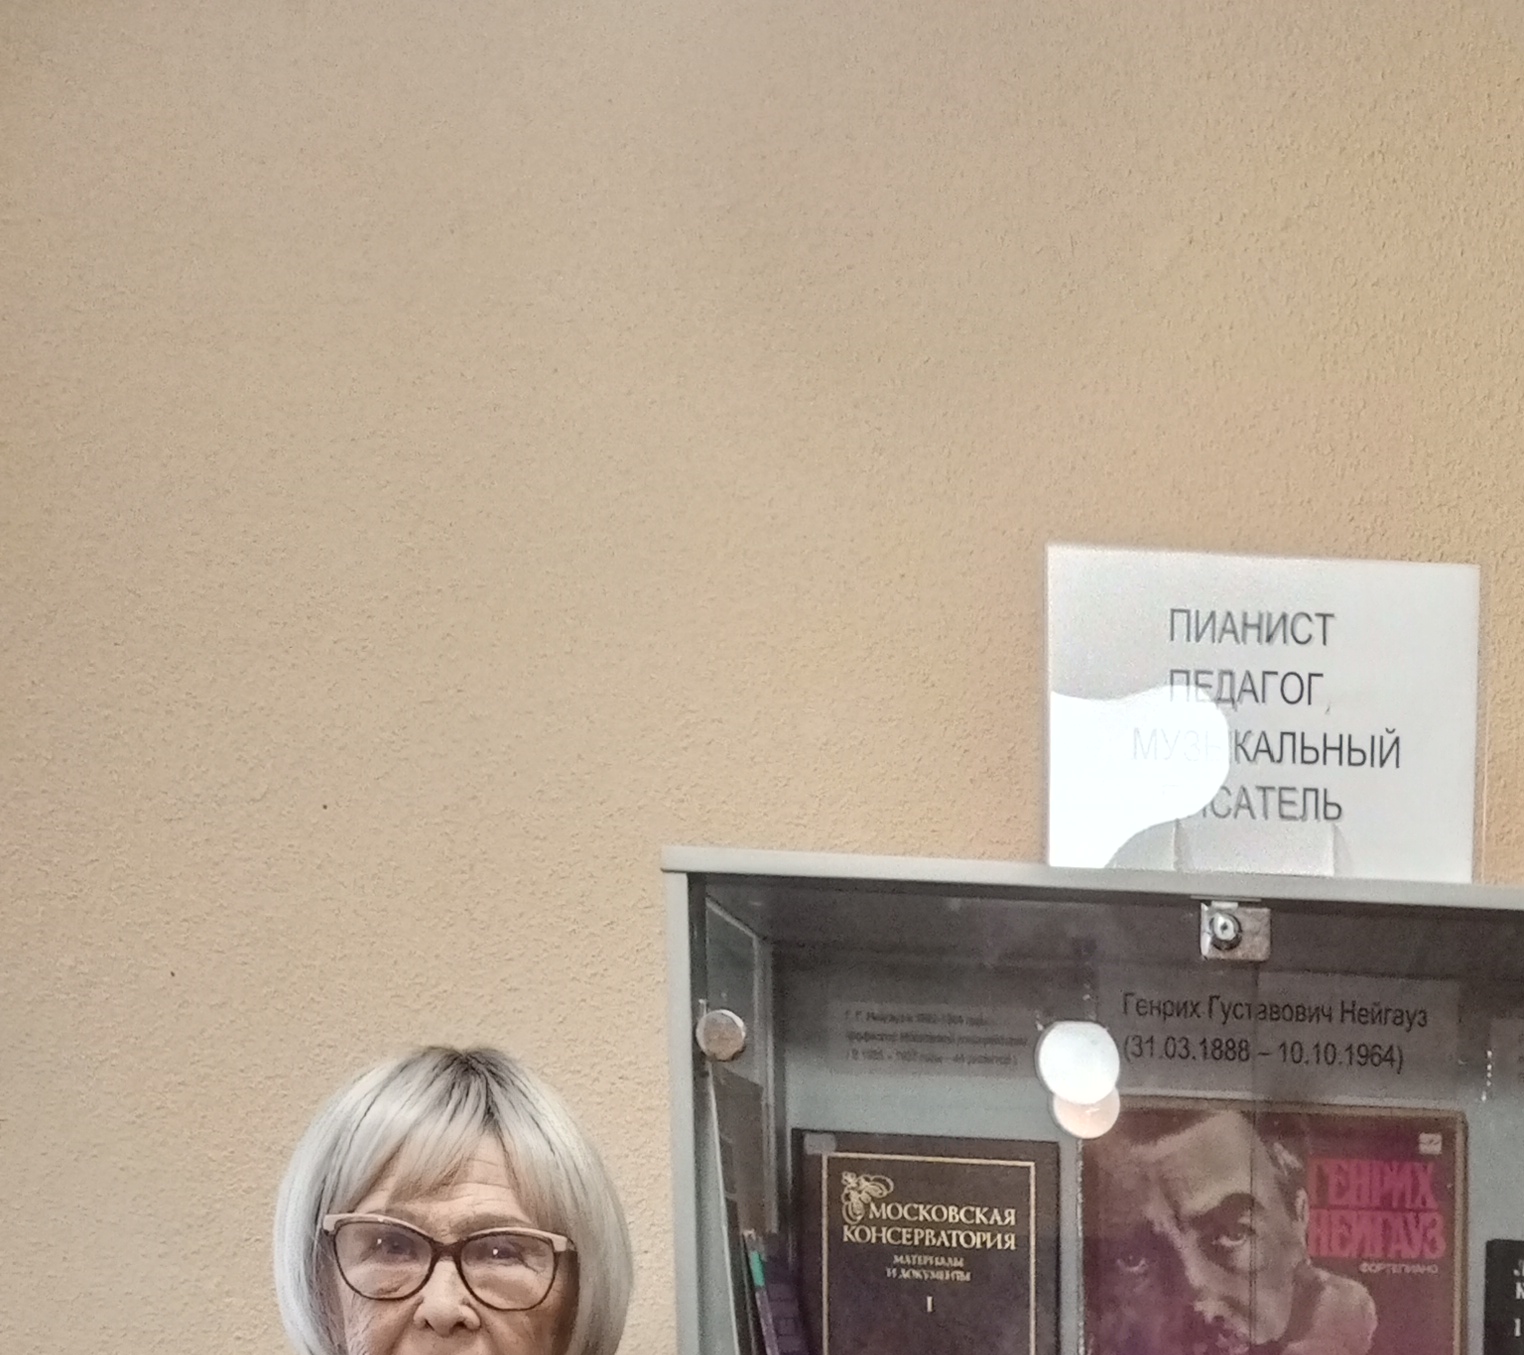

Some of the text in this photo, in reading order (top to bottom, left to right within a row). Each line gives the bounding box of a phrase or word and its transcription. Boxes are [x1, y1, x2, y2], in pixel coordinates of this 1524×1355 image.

[1169, 608, 1336, 646] ПИАНИСТ
[1162, 784, 1343, 822] САТЕЛЬ
[1122, 993, 1428, 1032] Генрих Густавович Нейгауз
[1123, 1034, 1250, 1063] (31.03.1888
[1279, 1040, 1403, 1073] 10.10.1964)
[1308, 1158, 1438, 1209] ГЕНРИХ
[868, 1202, 1016, 1226] МОСКОВСКАЯ
[843, 1225, 1016, 1250] КОНСЕРВАТОРИЯ
[1308, 1209, 1446, 1259] НЕЙГАУЗ
